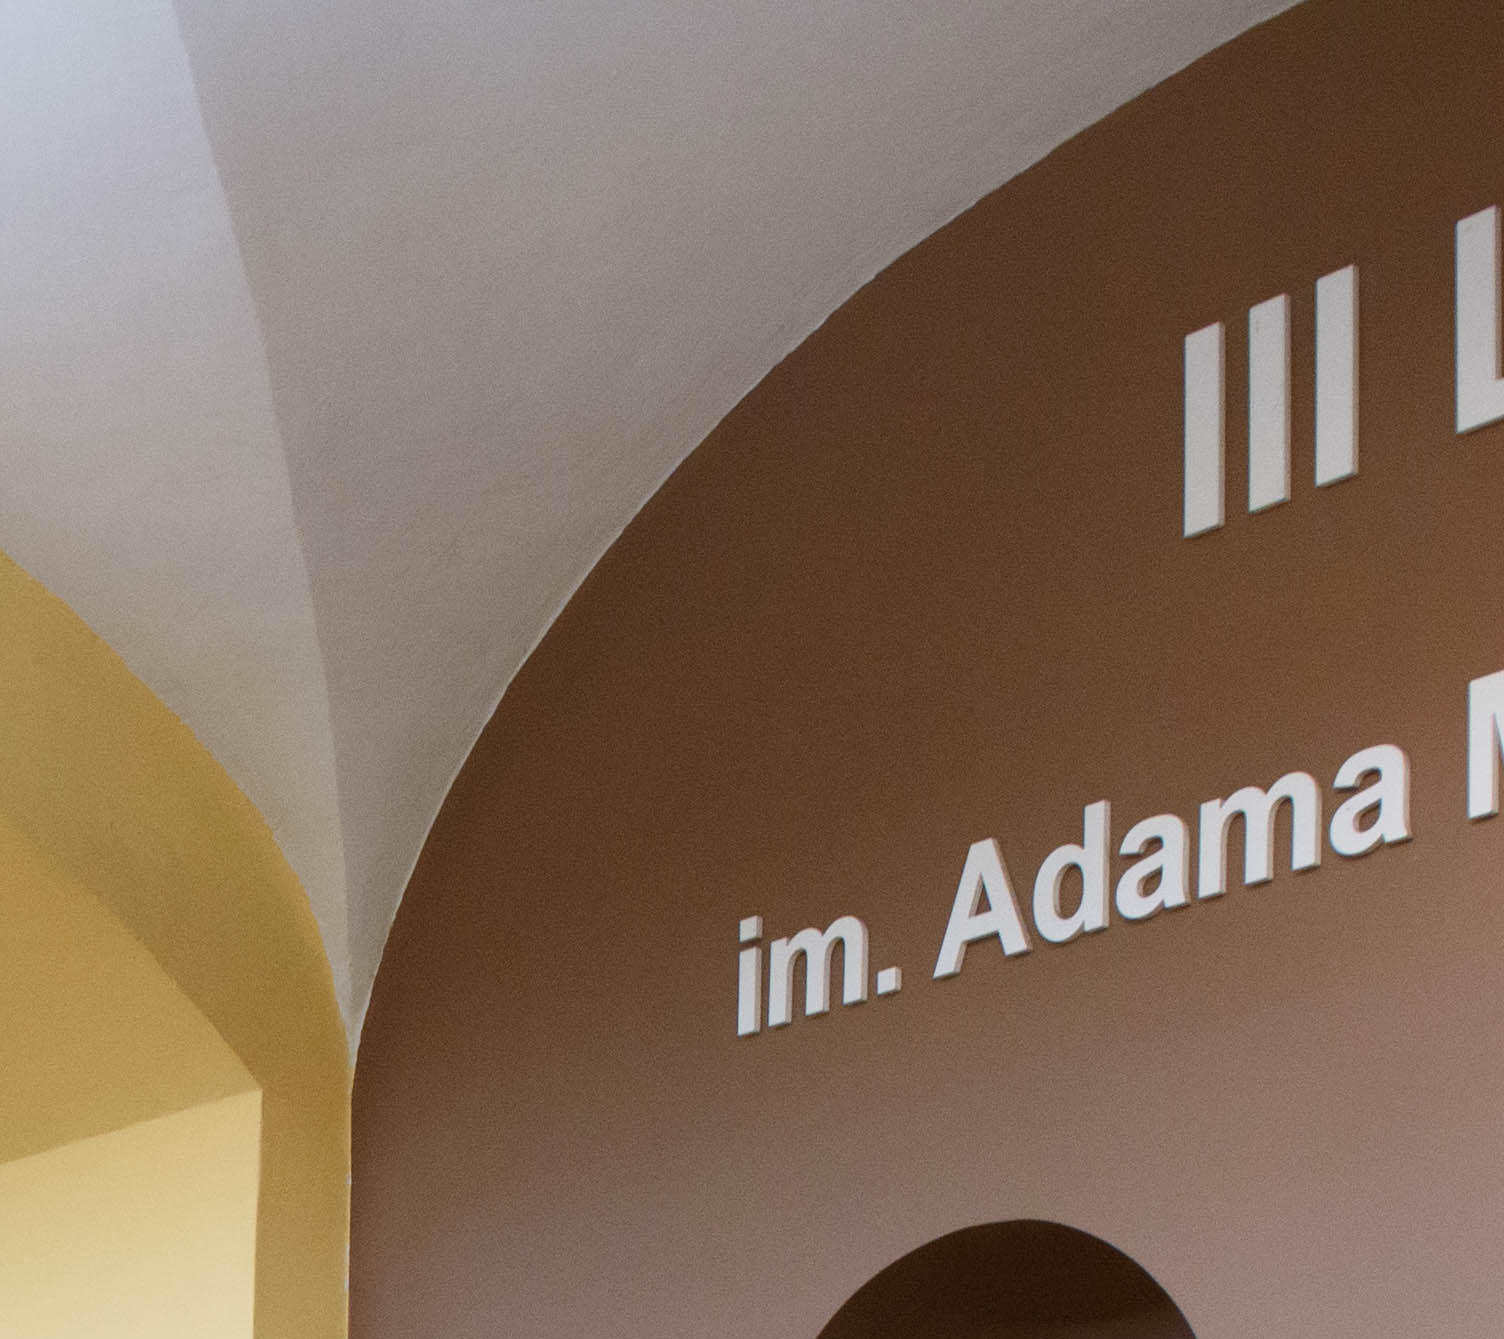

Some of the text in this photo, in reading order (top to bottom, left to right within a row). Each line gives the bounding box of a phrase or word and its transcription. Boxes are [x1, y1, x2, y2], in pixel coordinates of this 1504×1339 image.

[1182, 264, 1360, 538] III
[736, 914, 901, 1037] im.
[932, 742, 1411, 981] Adama
